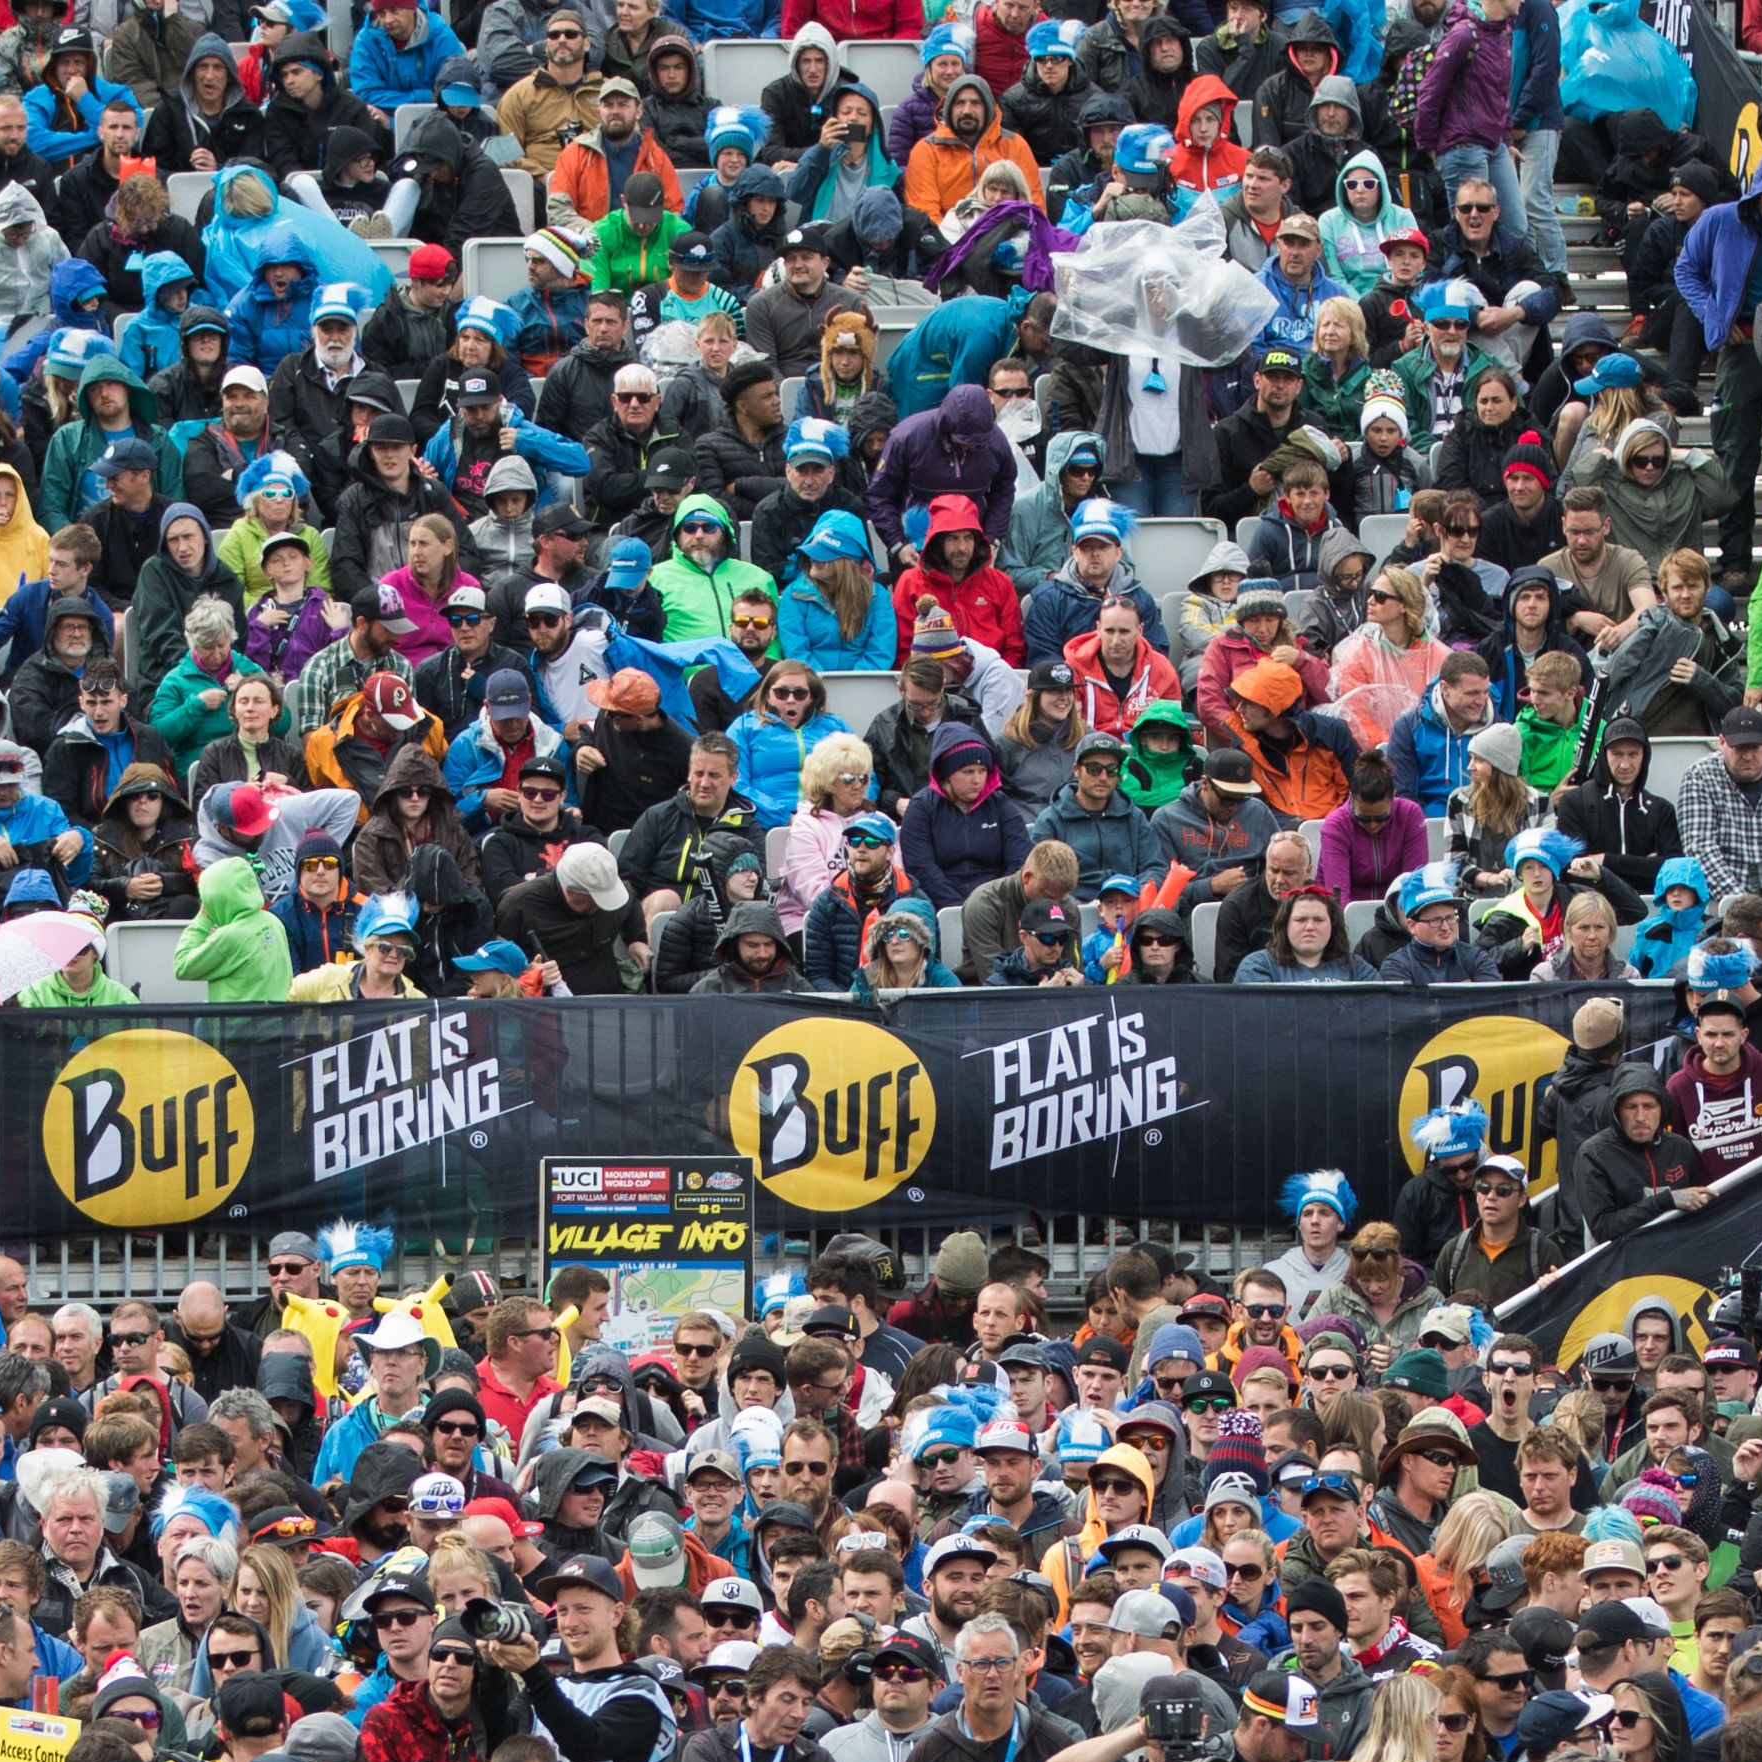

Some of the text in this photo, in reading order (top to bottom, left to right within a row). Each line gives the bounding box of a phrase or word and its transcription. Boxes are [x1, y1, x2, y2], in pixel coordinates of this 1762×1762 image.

[312, 1012, 468, 1113] FLAT IS
[992, 1012, 1147, 1104] FLAT IS
[313, 1057, 502, 1183] BORING
[991, 1057, 1178, 1170] BORING
[560, 1171, 598, 1187] UCI
[604, 1171, 667, 1179] MOUNTAIN BIKE
[548, 1220, 750, 1255] VILLAGE INFO
[619, 1262, 678, 1270] VILLAGE MAP
[1, 1739, 32, 1762] Access
